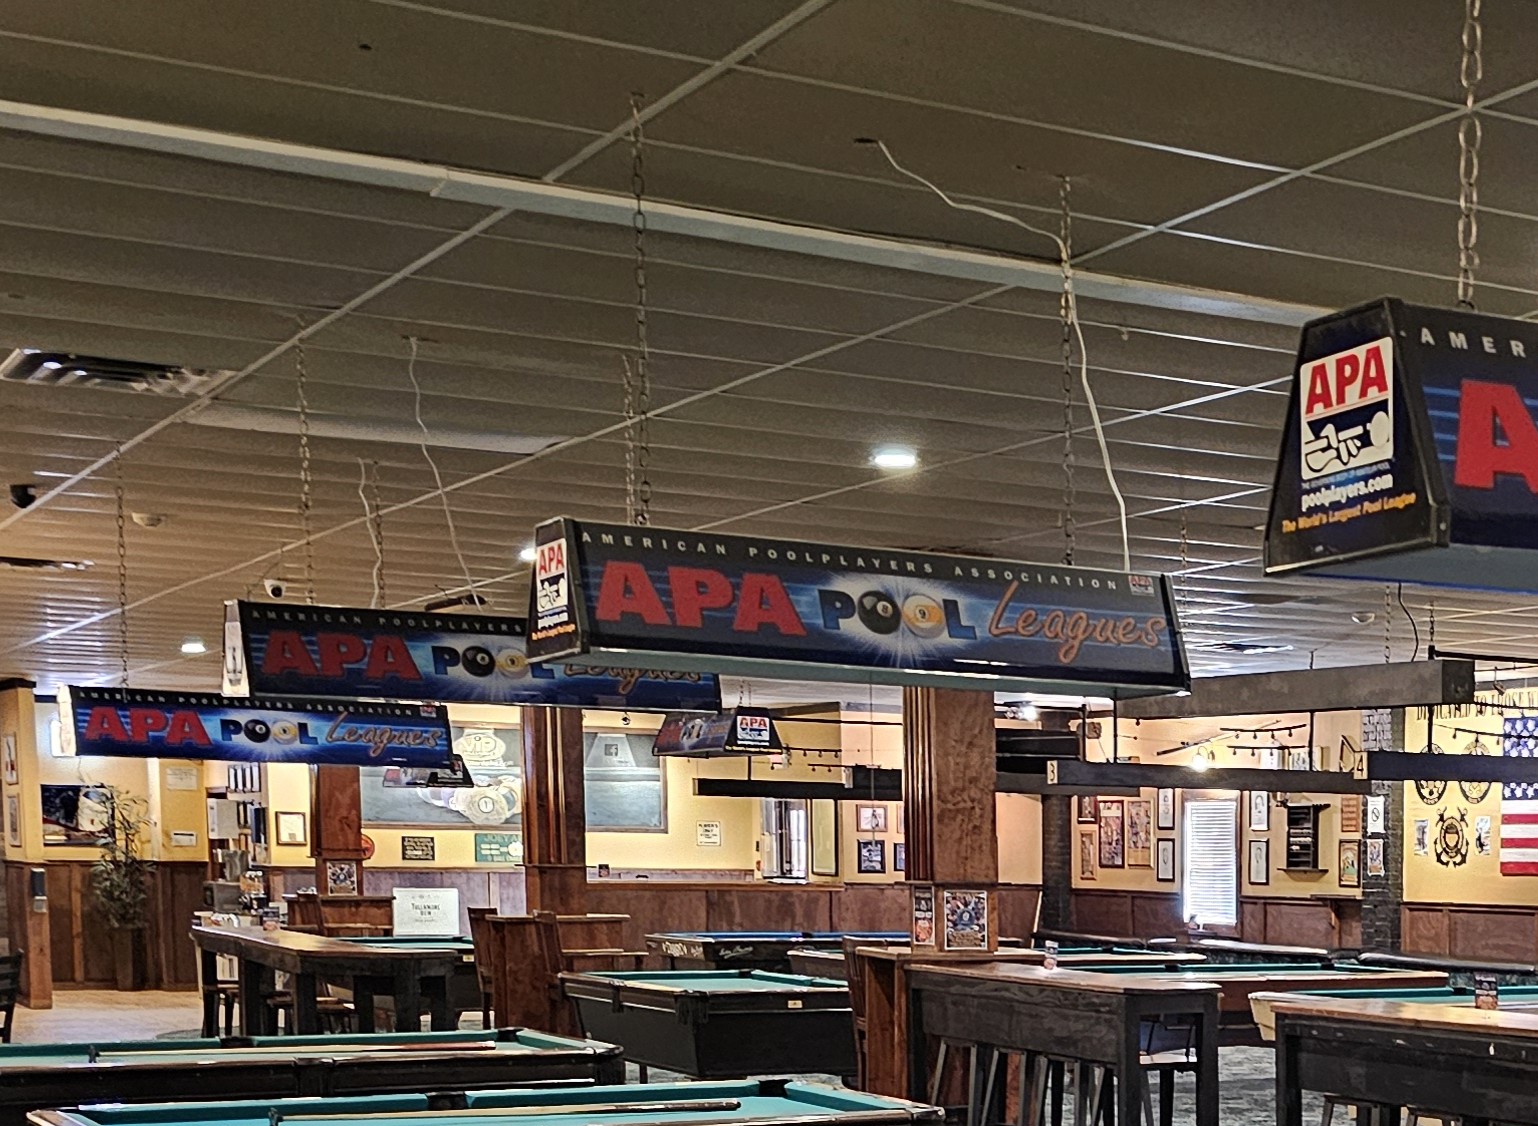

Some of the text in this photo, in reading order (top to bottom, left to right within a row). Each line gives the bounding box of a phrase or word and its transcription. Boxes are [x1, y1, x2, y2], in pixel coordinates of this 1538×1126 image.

[1305, 346, 1388, 415] APA
[1302, 474, 1393, 512] poolplayers.com
[539, 543, 564, 575] APA
[582, 532, 1117, 590] AMERICAN POOLPLAYERS ASSOCIATION
[252, 610, 361, 625] AMERICAN
[379, 617, 522, 633] POOLPLAYERS
[595, 560, 1167, 664] APA POOL Leagues
[261, 630, 423, 681] APA
[79, 691, 165, 703] AMERICAN
[179, 697, 293, 710] POOLPLAYERS
[306, 704, 412, 716] ASSOCIATION
[84, 706, 212, 746] APA
[325, 711, 443, 757] Leagues
[740, 717, 768, 728] APA
[1049, 762, 1056, 782] 3
[1356, 754, 1365, 778] 4
